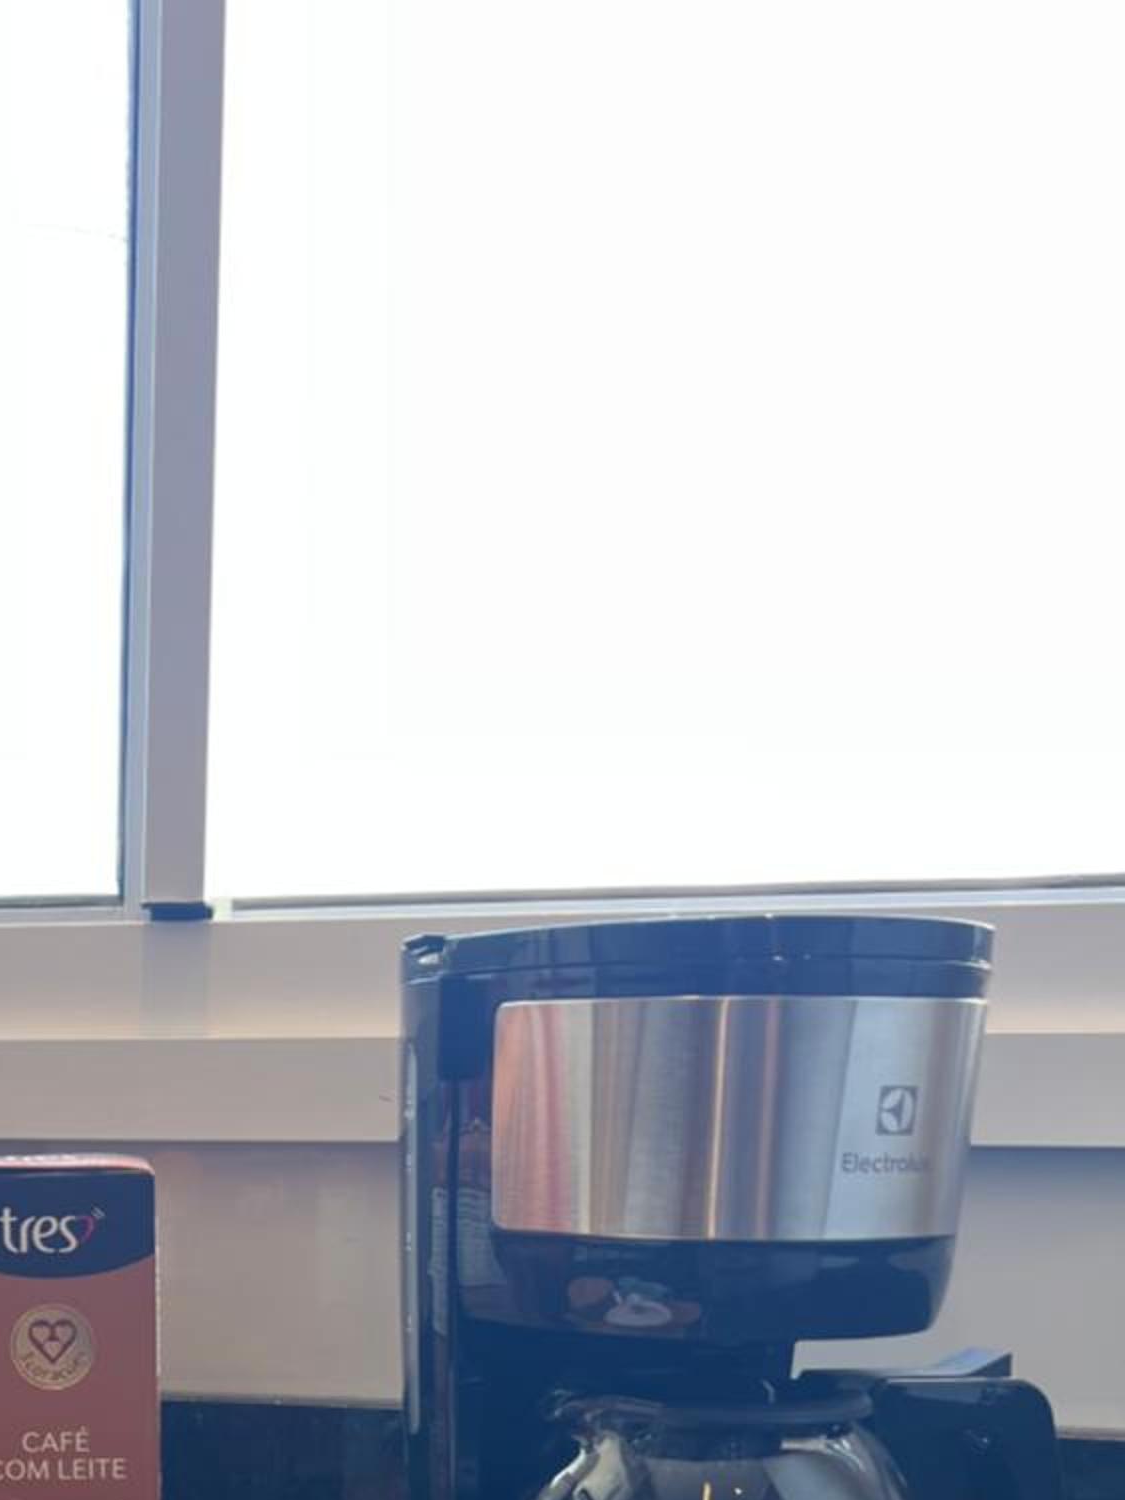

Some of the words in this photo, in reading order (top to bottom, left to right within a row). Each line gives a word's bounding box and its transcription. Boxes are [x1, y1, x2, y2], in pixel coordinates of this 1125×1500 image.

[0, 1207, 81, 1254] tres
[22, 1426, 90, 1452] CAFÉ
[59, 1458, 127, 1480] LEITE
